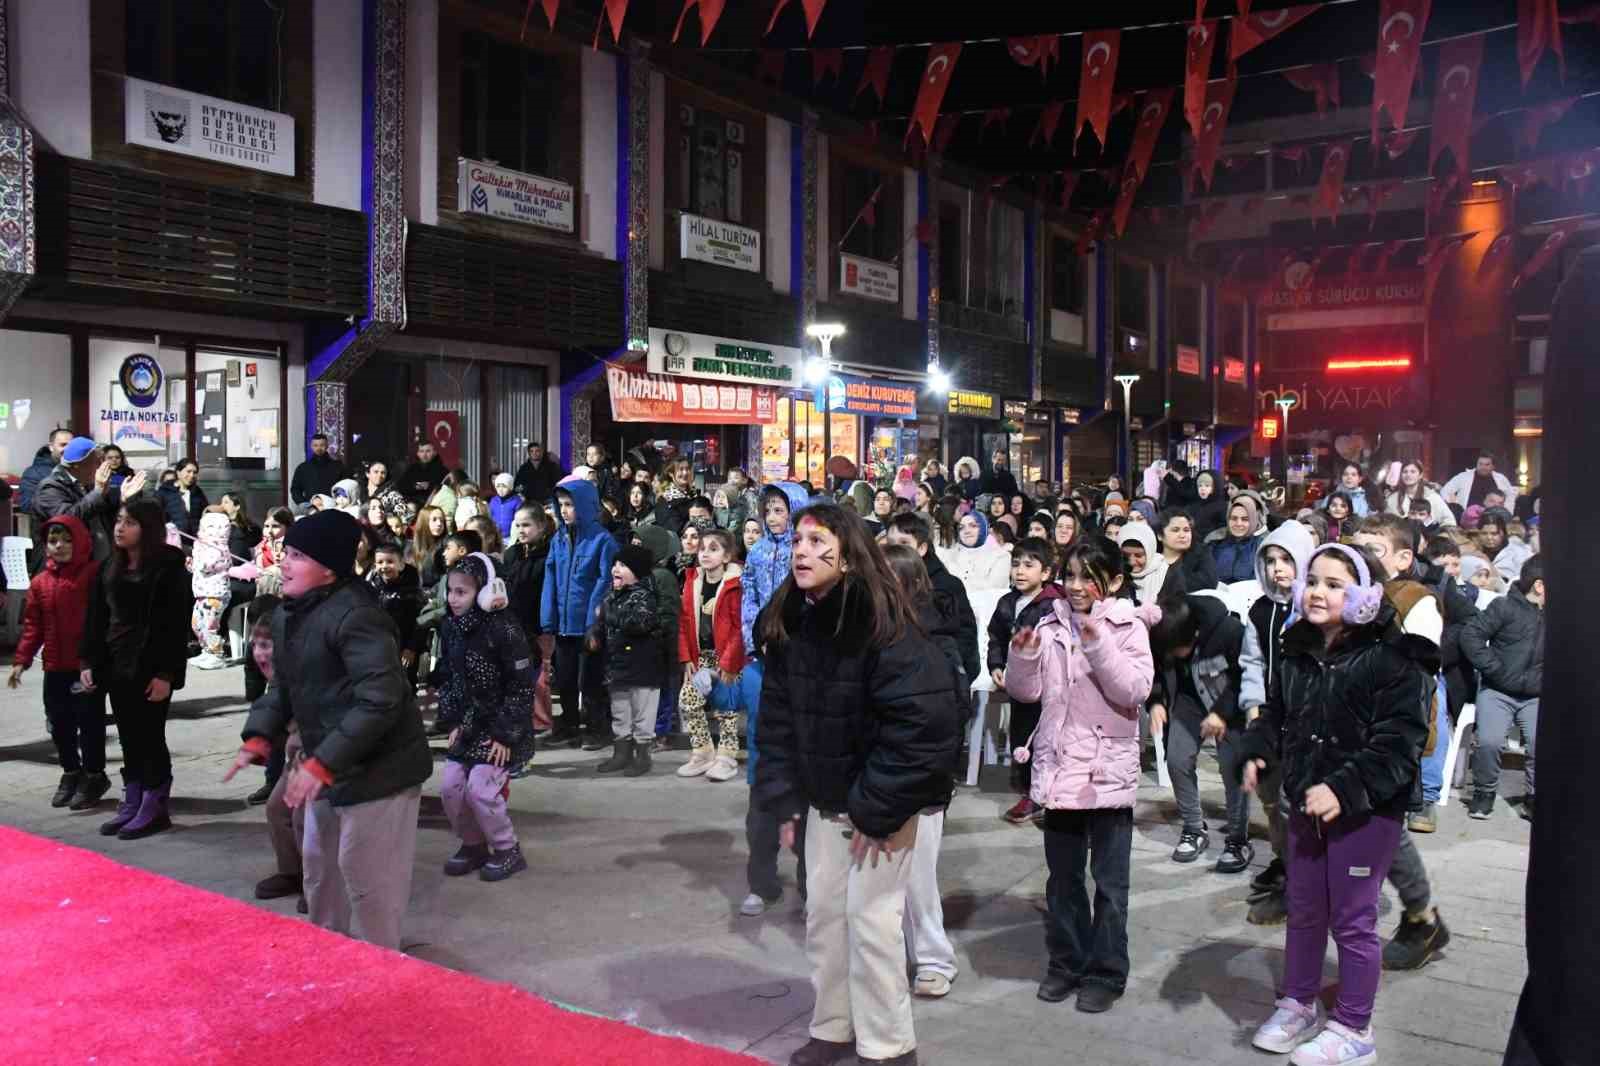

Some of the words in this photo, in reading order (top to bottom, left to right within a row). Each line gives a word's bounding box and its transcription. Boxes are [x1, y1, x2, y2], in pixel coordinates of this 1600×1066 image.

[541, 198, 563, 211] PROJE
[690, 218, 720, 240] HİLAL
[722, 228, 757, 248] TURİZM
[607, 366, 678, 401] RAMAZAN
[1316, 386, 1403, 410] YATAK
